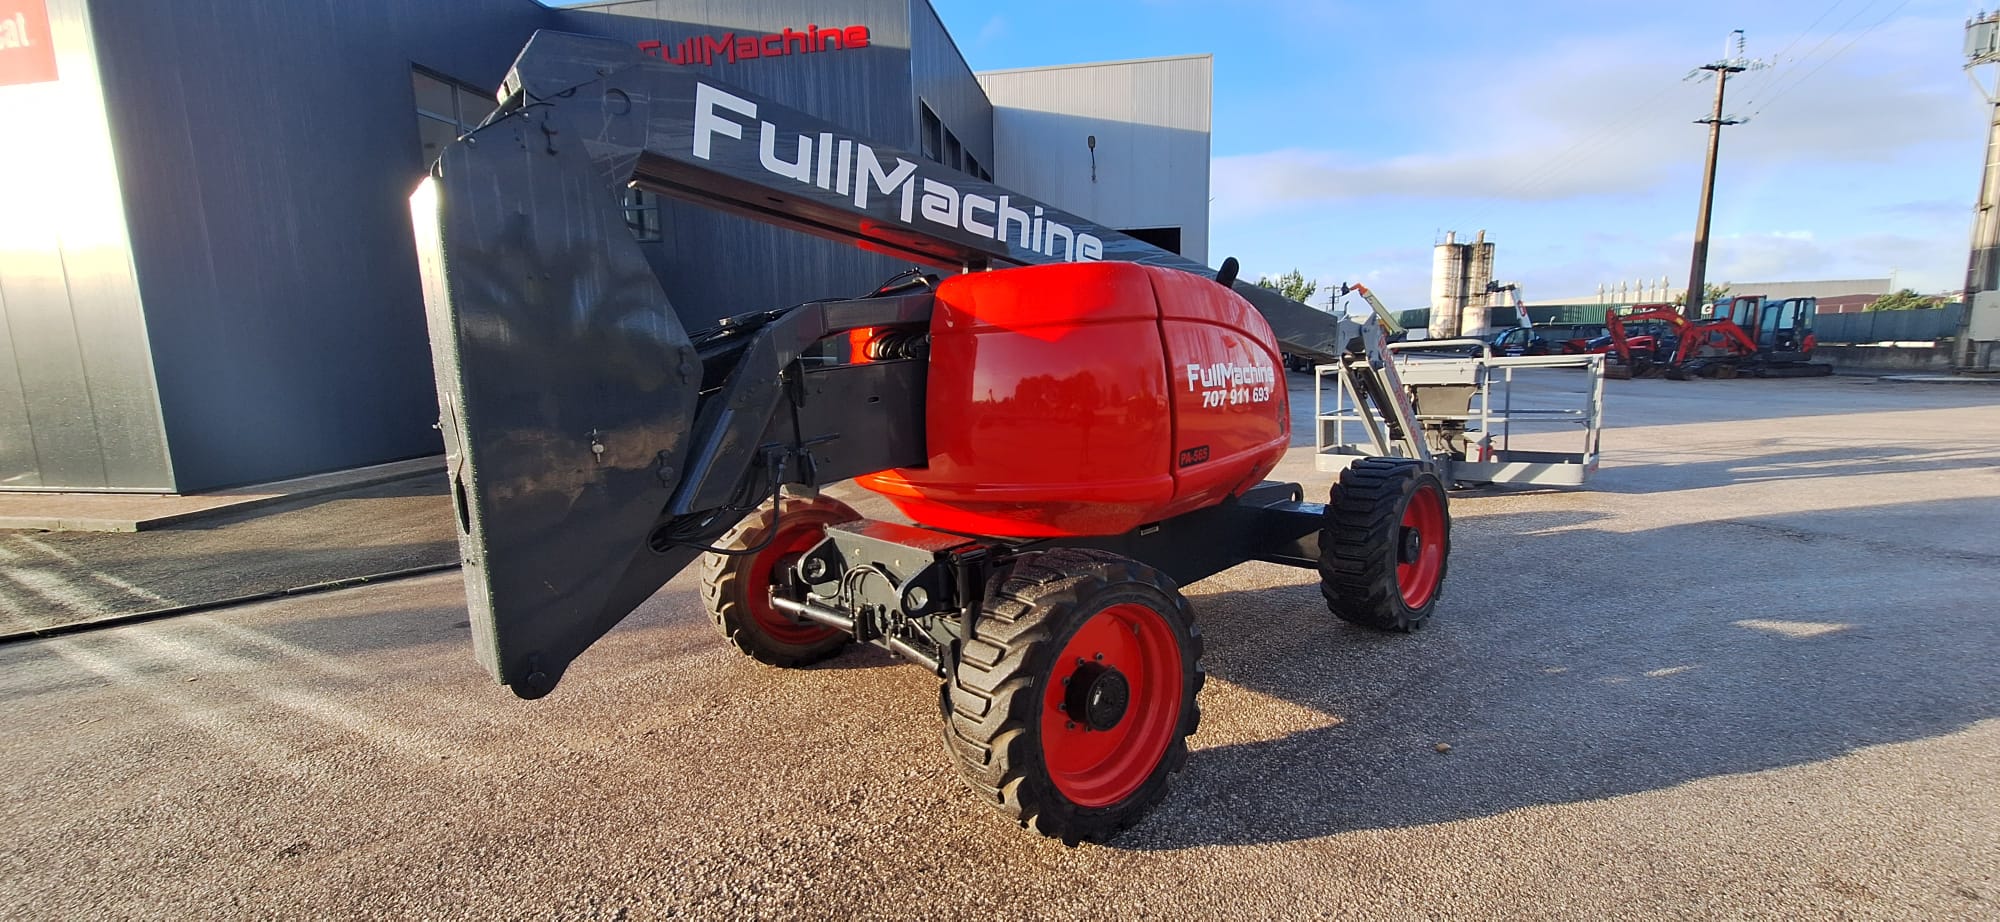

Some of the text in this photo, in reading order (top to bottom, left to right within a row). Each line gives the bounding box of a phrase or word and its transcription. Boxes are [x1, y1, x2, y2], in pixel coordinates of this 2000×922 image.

[637, 24, 870, 66] FullMachine
[692, 82, 1103, 262] FullMachine
[1187, 362, 1275, 392] FullMachine
[1202, 386, 1270, 408] 707 911 693
